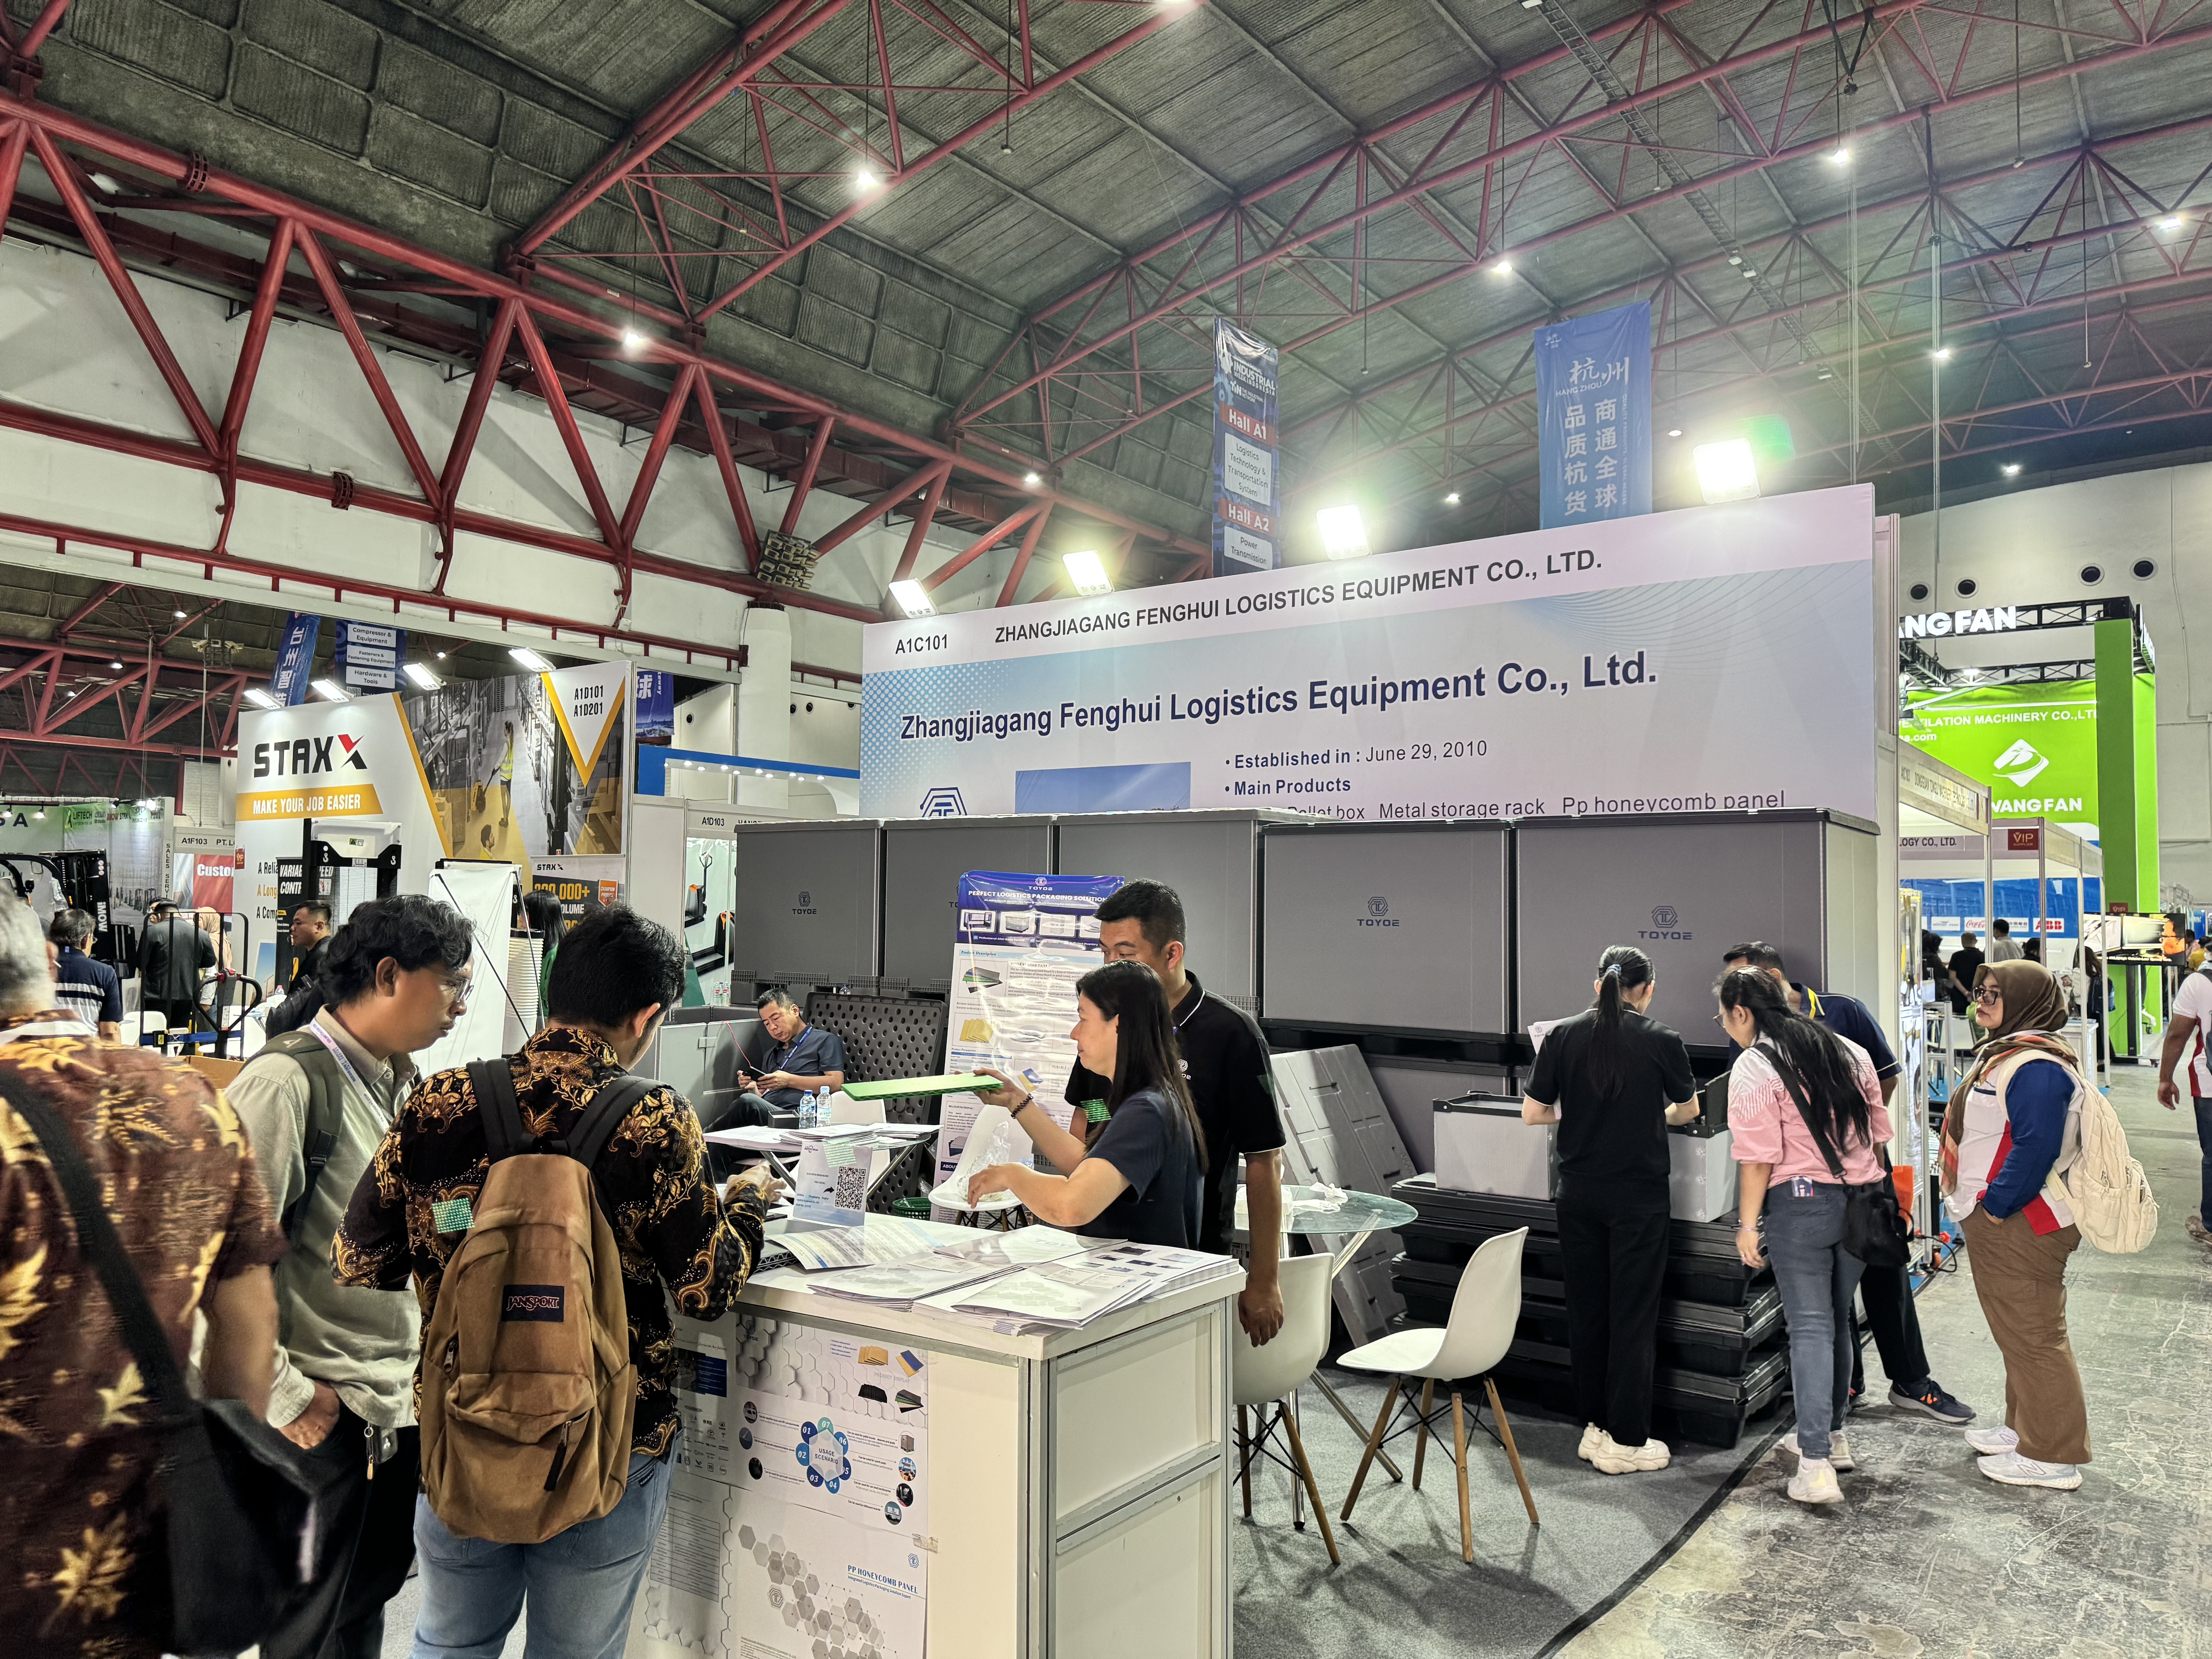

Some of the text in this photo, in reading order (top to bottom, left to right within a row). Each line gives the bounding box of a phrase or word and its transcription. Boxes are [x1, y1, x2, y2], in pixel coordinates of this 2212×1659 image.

[1234, 361, 1275, 390] INDUSTRIAL
[1570, 357, 1629, 386] 杭州
[1247, 378, 1275, 395] INDONESIA
[1556, 381, 1602, 397] HANG ZHOU
[1230, 409, 1266, 440] Hall A1
[1237, 443, 1259, 460] Logistics
[1595, 398, 1618, 508] 商通全球
[1230, 453, 1261, 474] Technology
[1565, 404, 1587, 516] 品质杭货
[1228, 465, 1268, 488] Transportation
[1239, 482, 1257, 496] System
[1229, 503, 1269, 532] Hall A2
[1240, 537, 1257, 549] Power
[1231, 546, 1266, 565] Transmission
[995, 550, 1602, 643] ZHANGJIAGANG FENGHUI LOGISTICS EQUIPMENT CO., LTD.
[353, 627, 386, 637] Compressor
[357, 635, 387, 644] Equipment
[895, 634, 948, 654] A1C101
[574, 685, 604, 701] A1D101
[901, 651, 1656, 742] Zhangjiagang Fenghui Logistics Equipment Co., Ltd.
[574, 702, 603, 717] A1D201
[1899, 716, 1971, 728] EILATION
[1975, 712, 2049, 724] MACHINERY
[1235, 750, 1330, 768] Established
[1336, 748, 1350, 763] in
[1366, 746, 1406, 762] June
[1411, 744, 1437, 760] 29,
[1443, 740, 1487, 758] 2010
[1234, 778, 1351, 795] Main Products
[253, 793, 361, 814] MAKE YOUR JOB EASIER
[1288, 790, 1784, 819] llet box Metal storage rack Pp honeycomb panel
[73, 811, 93, 820] LIFTECH
[702, 817, 725, 826] A1D103
[1922, 838, 1938, 847] CO.,
[1941, 837, 1957, 846] LTD.
[2013, 832, 2033, 843] VIP
[258, 862, 262, 874] A
[257, 884, 278, 898] A Long
[97, 902, 108, 932] iMOW
[256, 906, 260, 918] A
[1357, 919, 1400, 927] TOYOE
[1637, 930, 1692, 940] TOYOE
[506, 1296, 559, 1310] JANSPORT
[839, 1437, 847, 1445] 06
[815, 1454, 838, 1464] SCENARIO
[819, 1448, 835, 1456] USAGE
[830, 1481, 837, 1489] 04
[858, 1568, 896, 1586] HONEYCOMB
[898, 1581, 918, 1594] PANEL
[875, 1584, 889, 1592] Packaging
